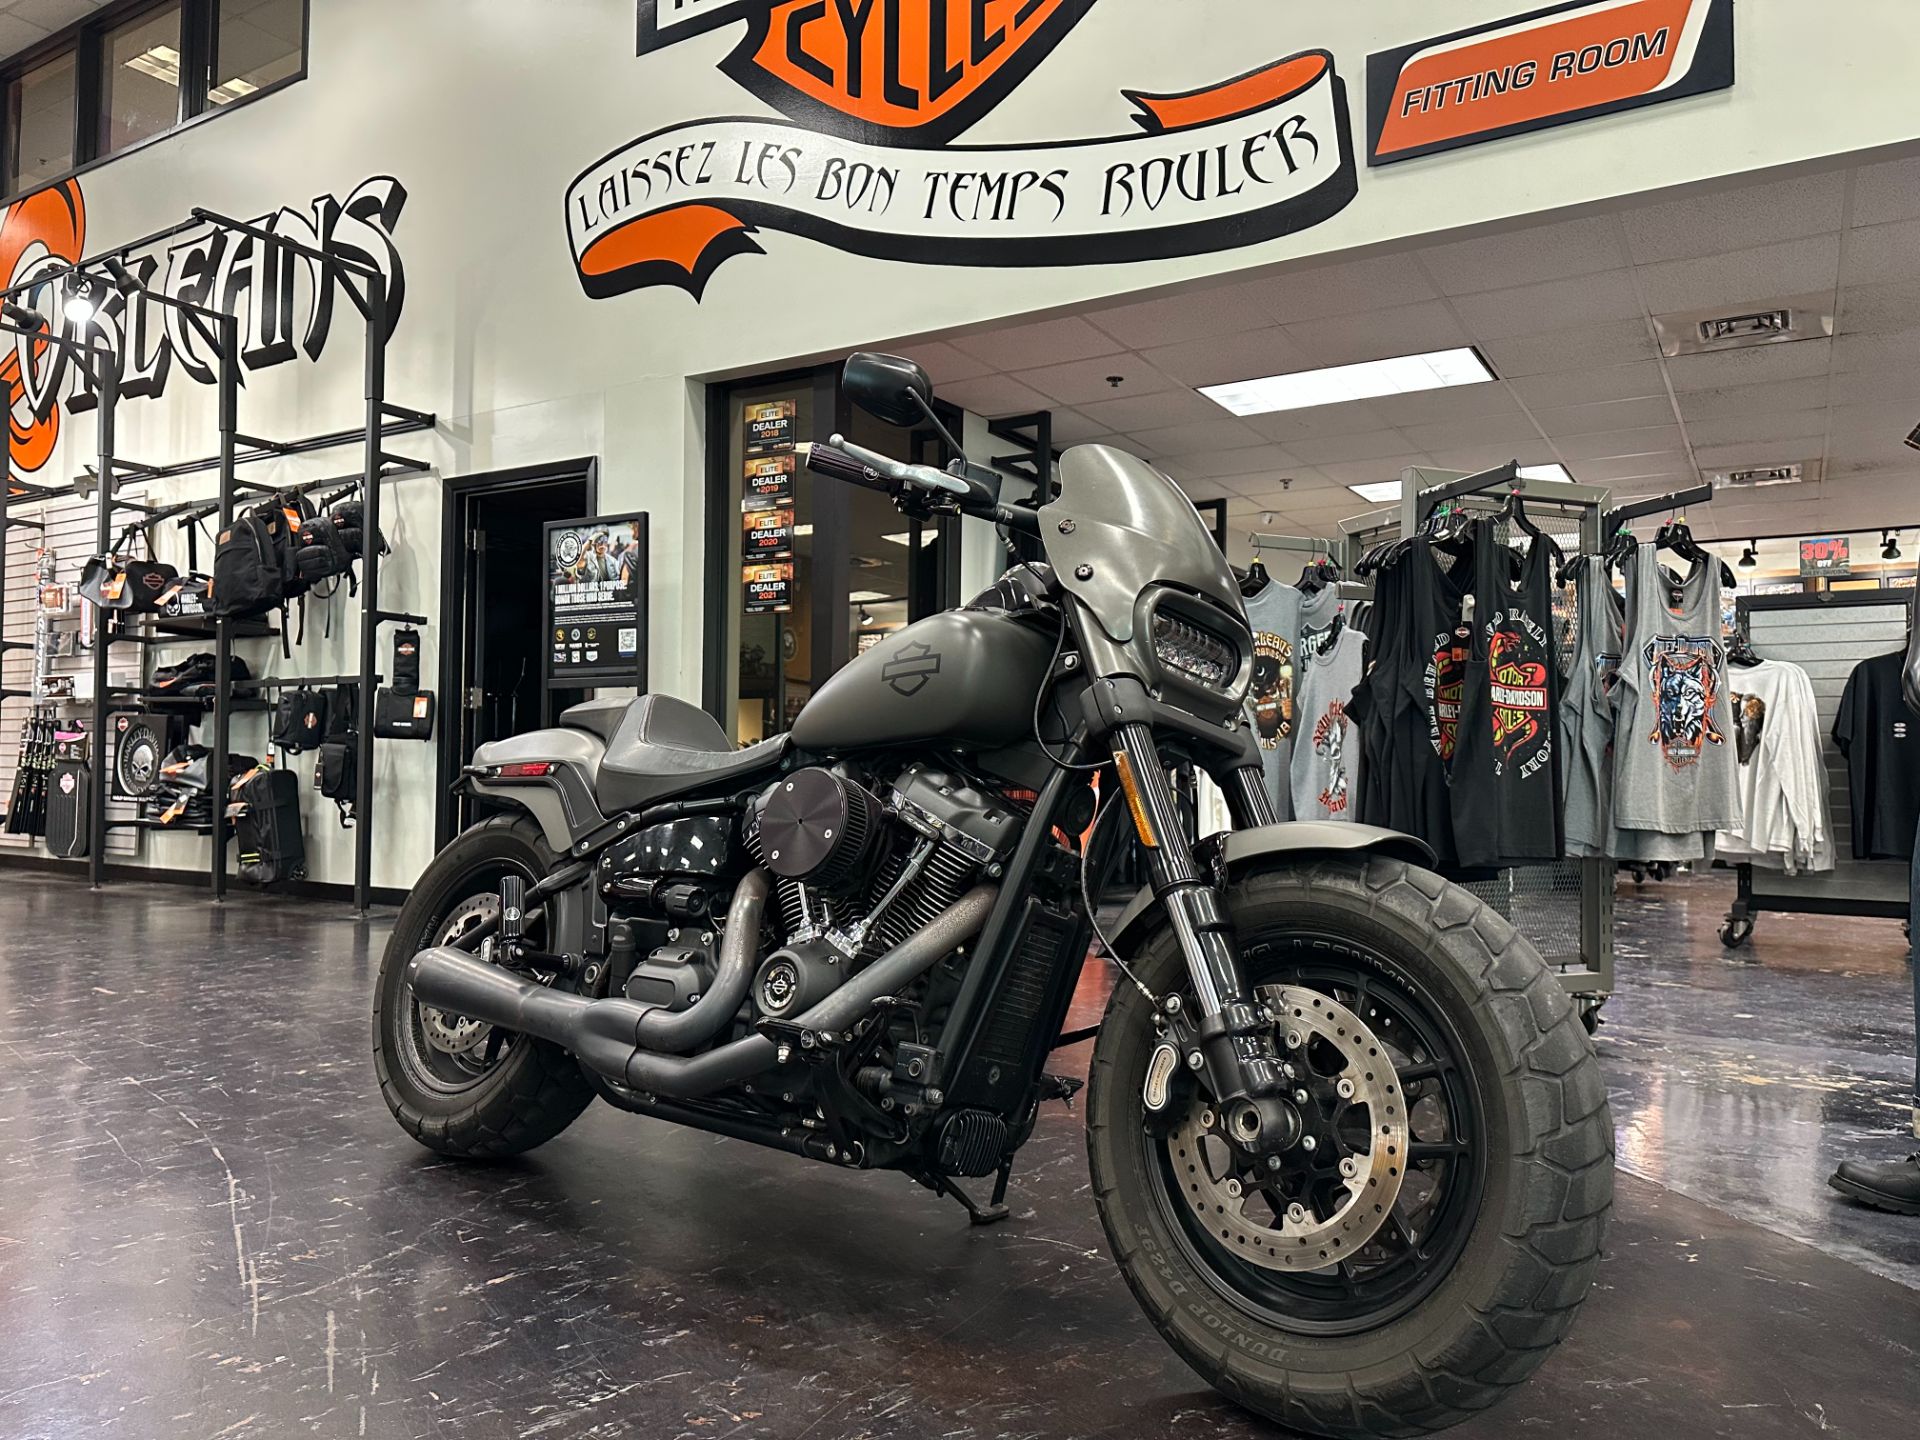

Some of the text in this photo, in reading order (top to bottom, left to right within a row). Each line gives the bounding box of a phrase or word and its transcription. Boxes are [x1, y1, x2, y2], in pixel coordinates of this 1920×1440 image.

[1401, 27, 1670, 118] FITTING ROOM
[578, 114, 1321, 231] LAISSEZ LES BON TEMPS ROULER
[761, 410, 779, 418] ELITE
[753, 420, 787, 432] DEALER
[761, 430, 779, 438] 2018
[761, 465, 779, 474] ELITE
[752, 475, 787, 487] DEALER
[760, 484, 779, 494] 2019
[759, 519, 777, 527] ELITE
[751, 528, 786, 540] DEALER
[758, 538, 778, 547] 2020
[1801, 539, 1848, 560] 30%
[758, 572, 777, 580] ELITE
[750, 582, 785, 593] DEALER
[758, 591, 777, 600] 2021
[1188, 1303, 1289, 1362] DUNLOP
